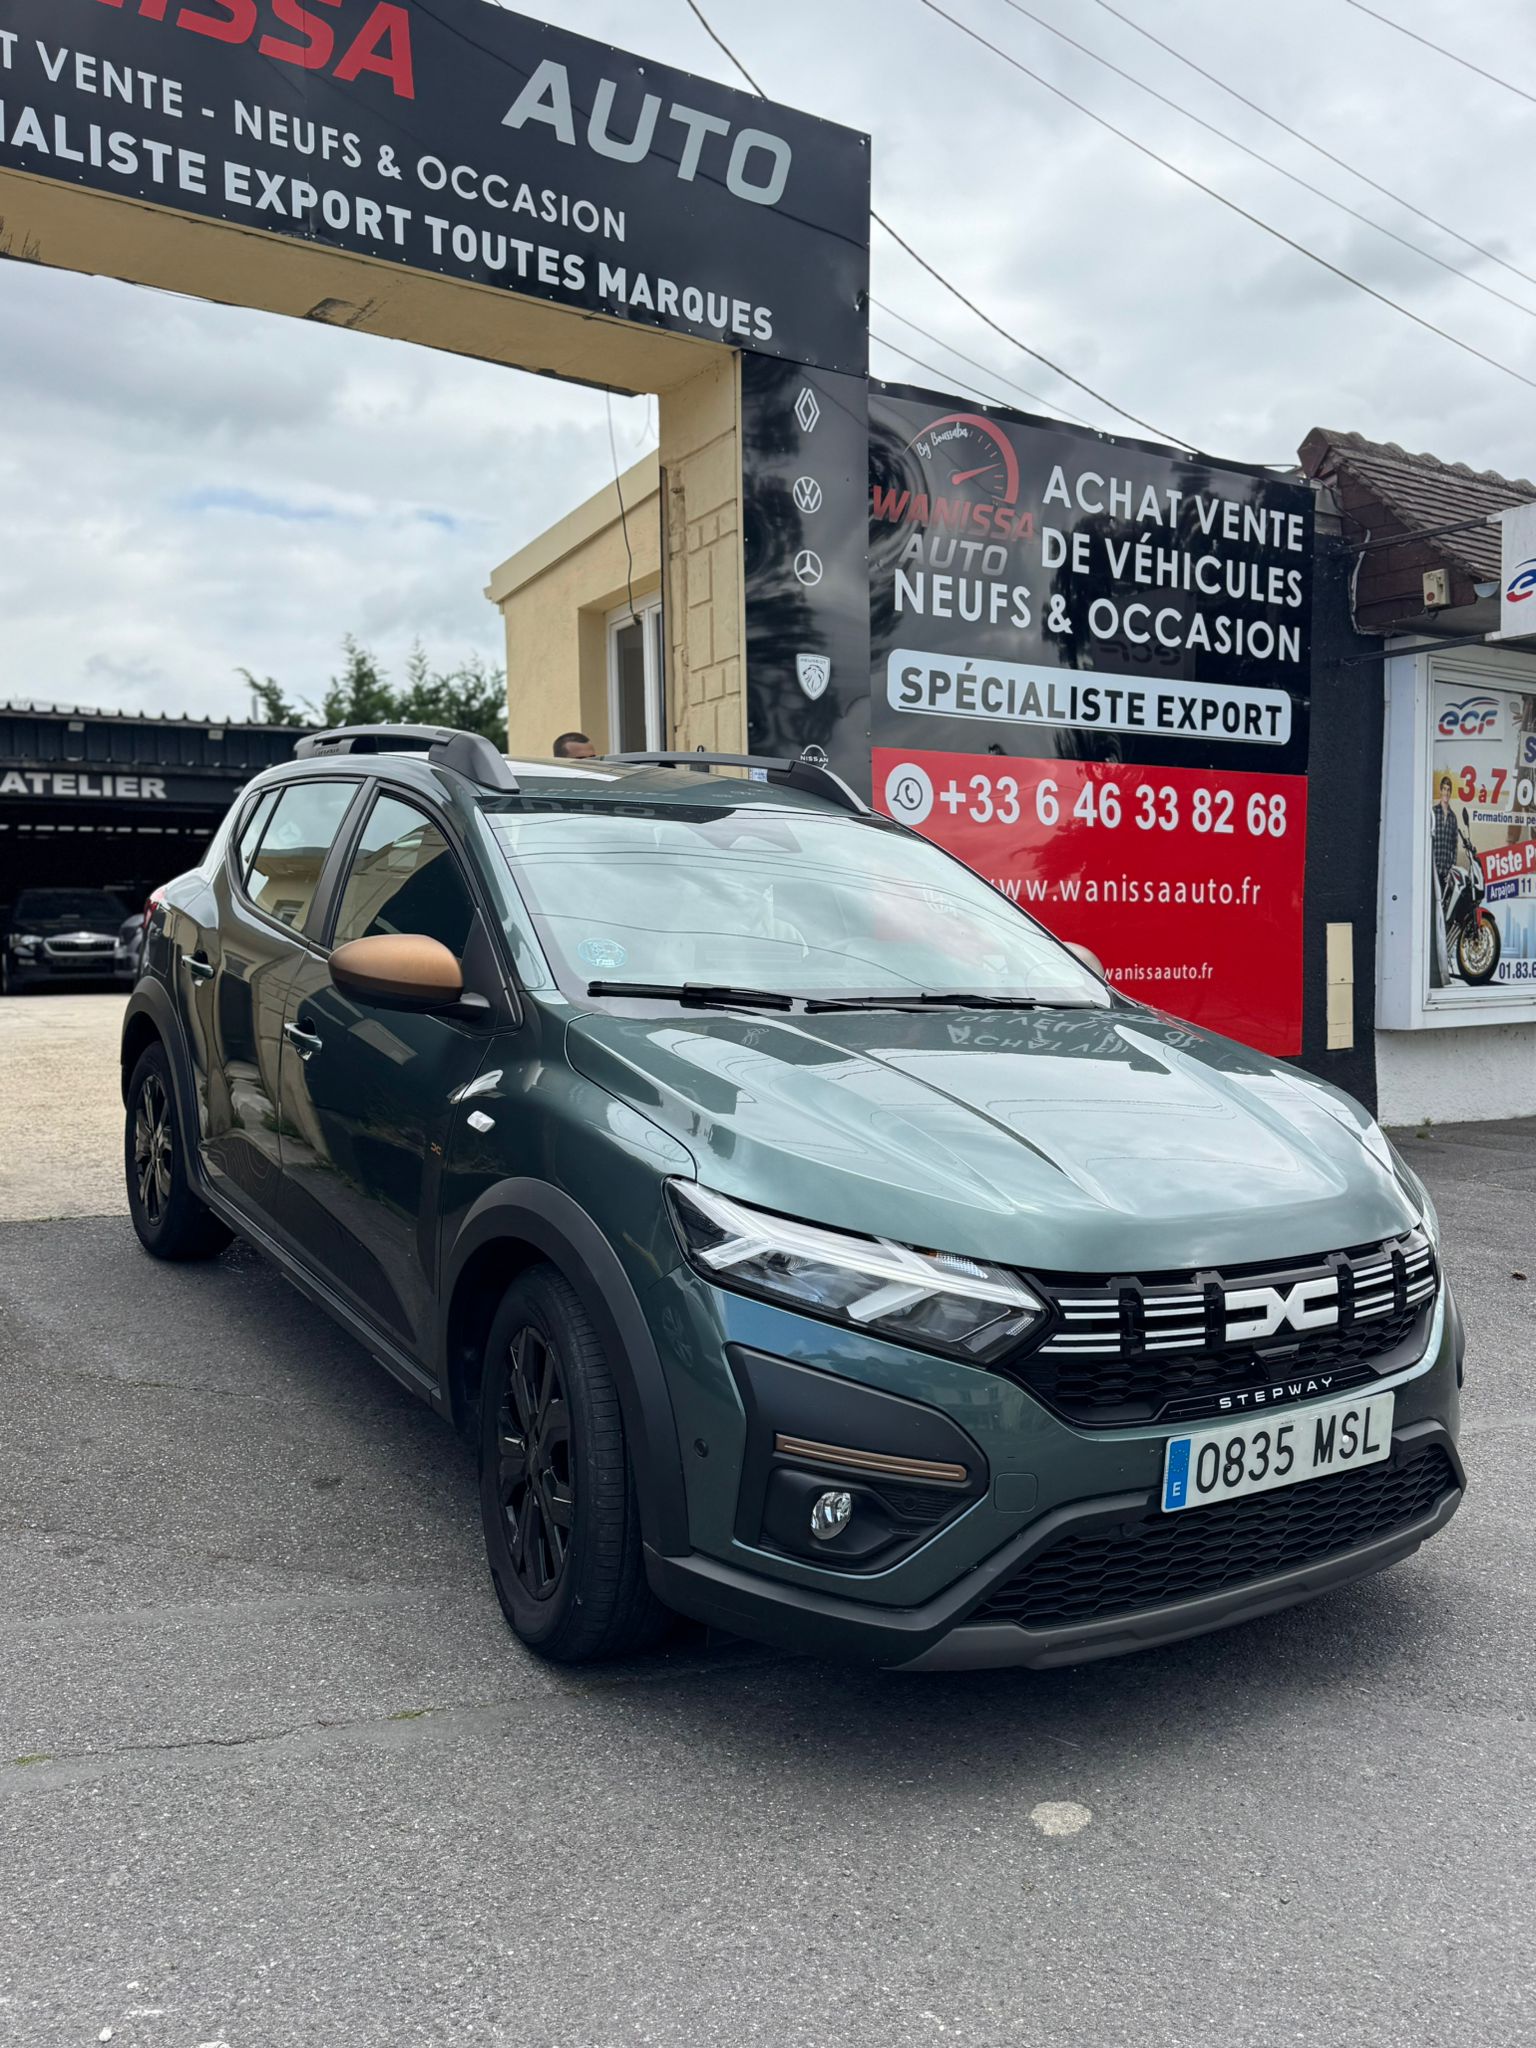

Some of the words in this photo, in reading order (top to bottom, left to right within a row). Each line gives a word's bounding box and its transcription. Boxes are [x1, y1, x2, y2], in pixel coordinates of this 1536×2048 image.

[36, 40, 183, 118] VENTE
[234, 100, 362, 168] NEUFS
[377, 144, 402, 180] &
[417, 155, 626, 242] OCCASION
[501, 59, 792, 206] AUTO
[224, 161, 412, 246] EXPORT
[424, 214, 586, 291] TOUTES
[599, 262, 773, 341] MARQUES
[916, 441, 932, 459] By
[873, 485, 1035, 542] WANISSA
[1043, 465, 1182, 529] ACHAT
[1195, 494, 1304, 552] VENTE
[899, 533, 1008, 576] AUTO
[1042, 526, 1091, 575] DE
[1104, 532, 1303, 608] VÉHICULES
[894, 568, 1031, 629] NEUFS
[1047, 593, 1074, 634] &
[1088, 597, 1301, 663] OCCASION
[899, 662, 1146, 726] SPÉCIALISTE
[1157, 695, 1282, 736] EXPORT
[0, 771, 167, 799] ATELIER
[940, 774, 1020, 824] +33
[1036, 779, 1059, 826] 6
[1073, 781, 1121, 829] 46
[1135, 784, 1179, 831] 33
[1192, 788, 1234, 833] 82
[1247, 792, 1287, 837] 68
[1458, 765, 1477, 802] 3
[1491, 768, 1507, 804] 7
[1472, 810, 1513, 824] Formation
[1514, 815, 1525, 824] au
[989, 874, 1261, 905] ww.wanissaauto.fr
[1486, 850, 1522, 880] Piste
[1490, 882, 1516, 899] Arpajon
[1521, 878, 1531, 893] 11
[1219, 1376, 1334, 1409] STEPWAY
[1172, 1481, 1182, 1497] E
[1196, 1424, 1295, 1494] 0835
[1313, 1406, 1381, 1467] MSL
